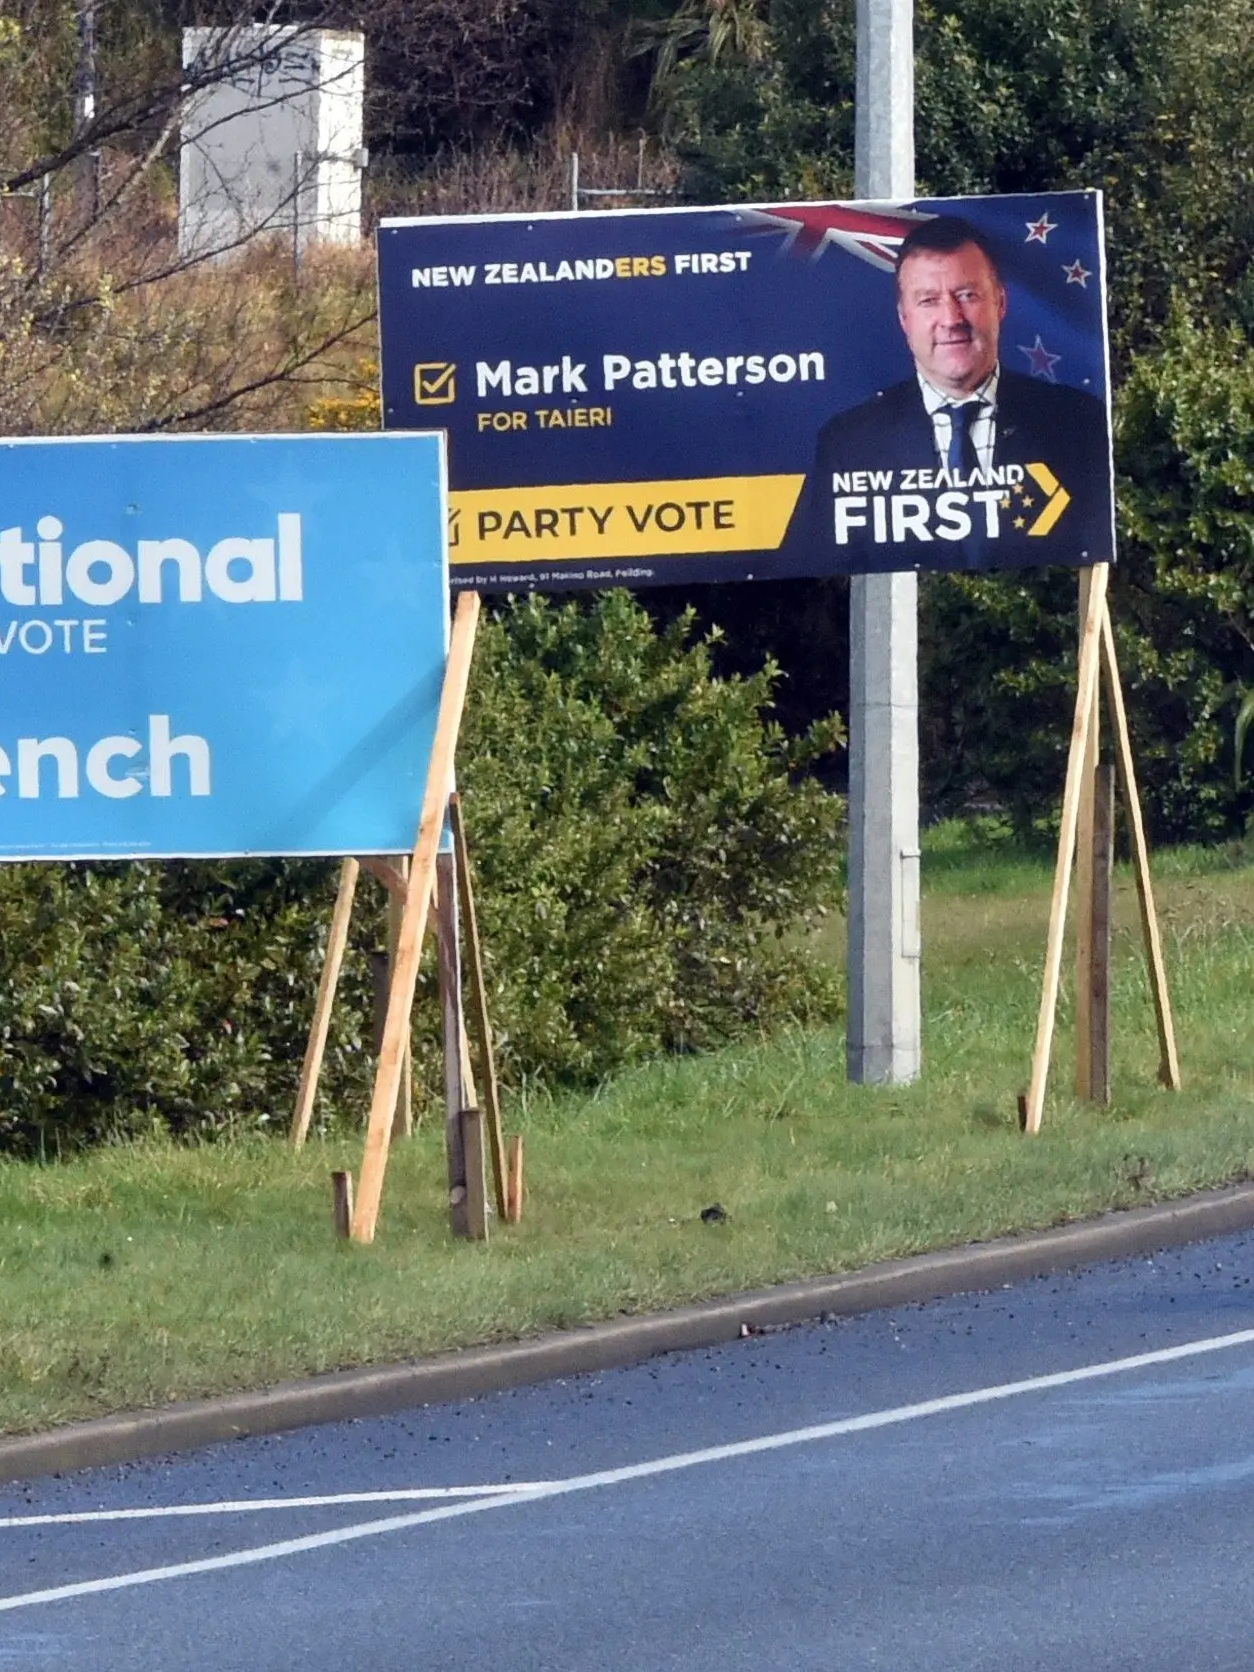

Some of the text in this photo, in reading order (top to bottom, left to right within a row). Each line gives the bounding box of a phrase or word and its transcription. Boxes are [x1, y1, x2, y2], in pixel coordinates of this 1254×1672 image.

[411, 251, 752, 288] NEW ZEALANDERS FIRST
[475, 351, 825, 397] Mark Patterson
[477, 407, 612, 432] FOR TAIERI
[832, 463, 1025, 493] NEW ZEALAND
[478, 500, 735, 541] PARTY VOTE
[834, 490, 1010, 545] FIRST
